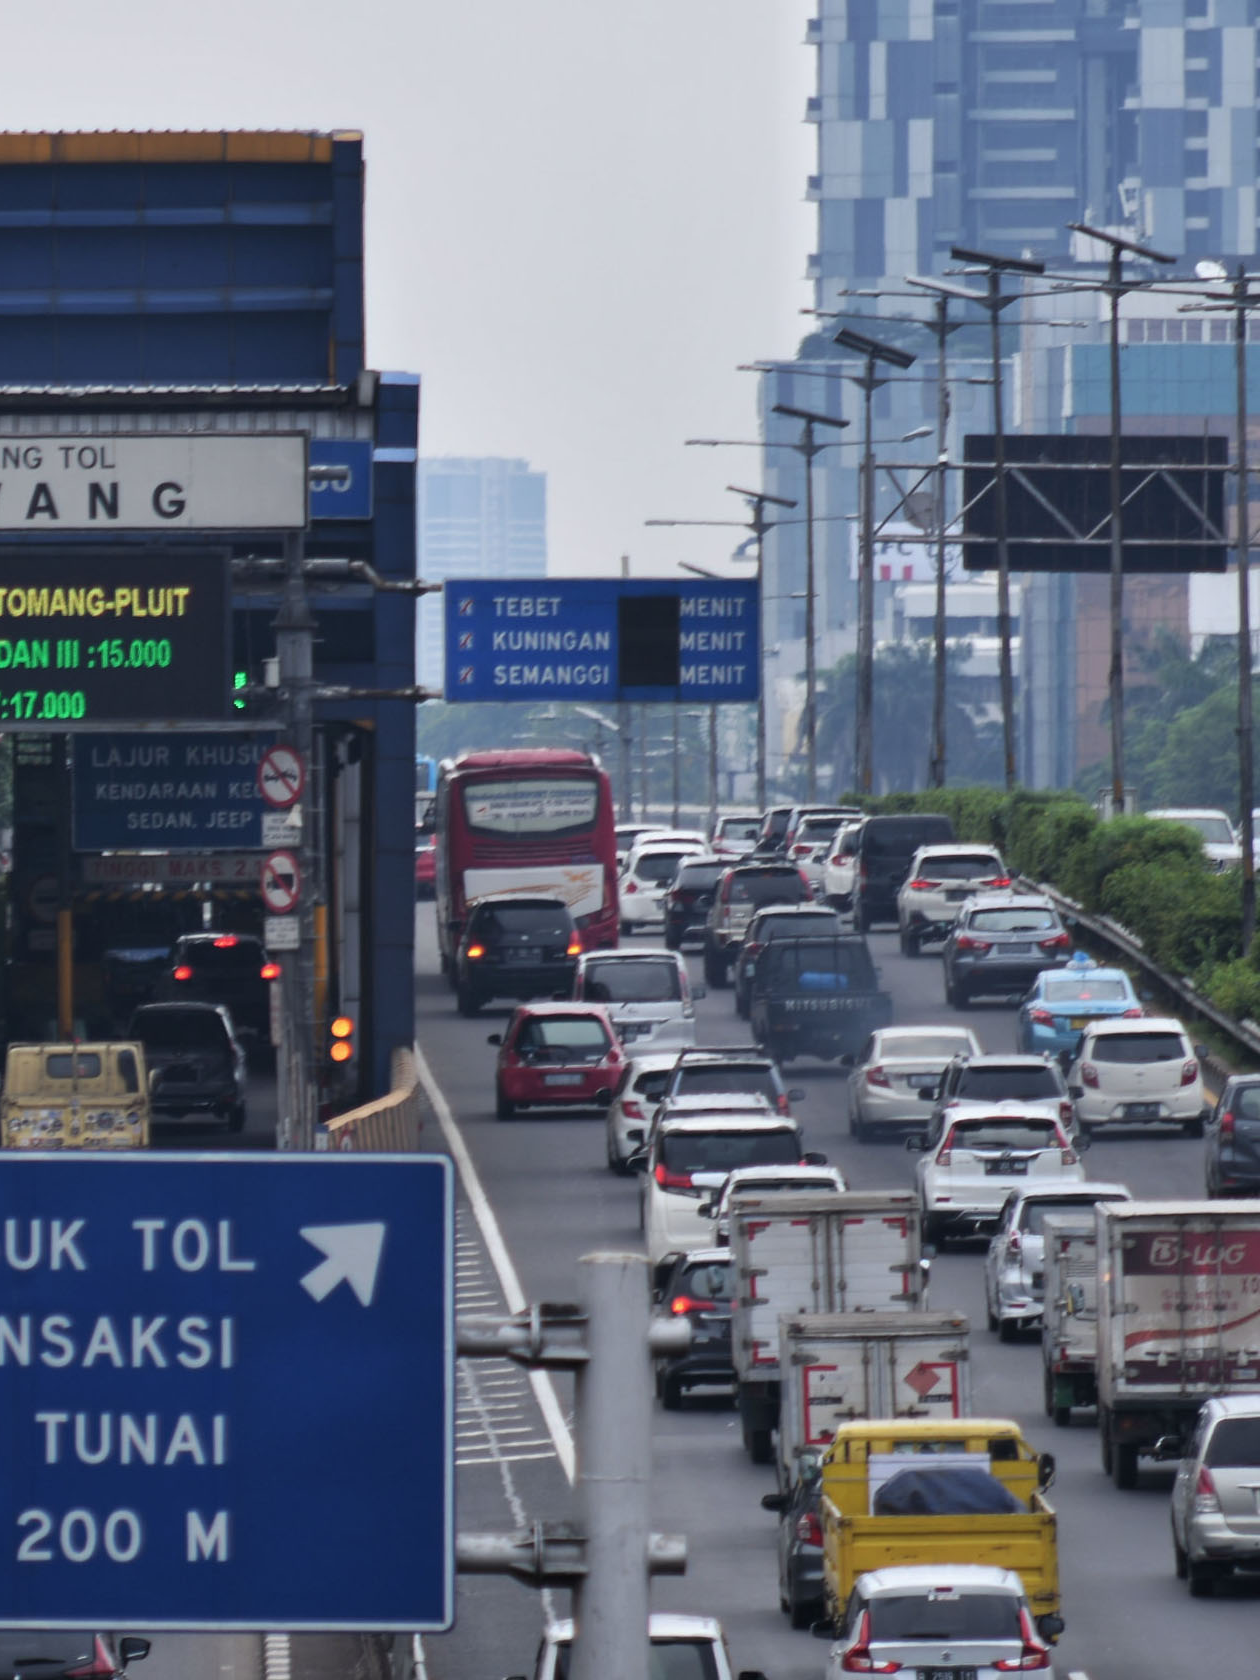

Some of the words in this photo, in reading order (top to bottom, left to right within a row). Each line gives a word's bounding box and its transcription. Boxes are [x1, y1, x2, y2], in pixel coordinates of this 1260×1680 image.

[58, 446, 115, 470] TOL
[492, 597, 561, 617] TEBET
[679, 597, 746, 617] MENIT
[493, 631, 610, 651] KUNINGAN
[679, 631, 746, 651] MENIT
[56, 640, 79, 669] III
[493, 665, 609, 686] SEMANGGI
[679, 665, 746, 685] MENIT
[91, 746, 170, 768] LAJUR
[186, 744, 266, 767] KHUSU
[95, 782, 217, 801] KENDARAAN
[205, 811, 253, 828] JEEP
[132, 1218, 256, 1273] TOL
[36, 1412, 226, 1466] TUNAI
[15, 1510, 142, 1562] 200
[186, 1511, 230, 1562] M
